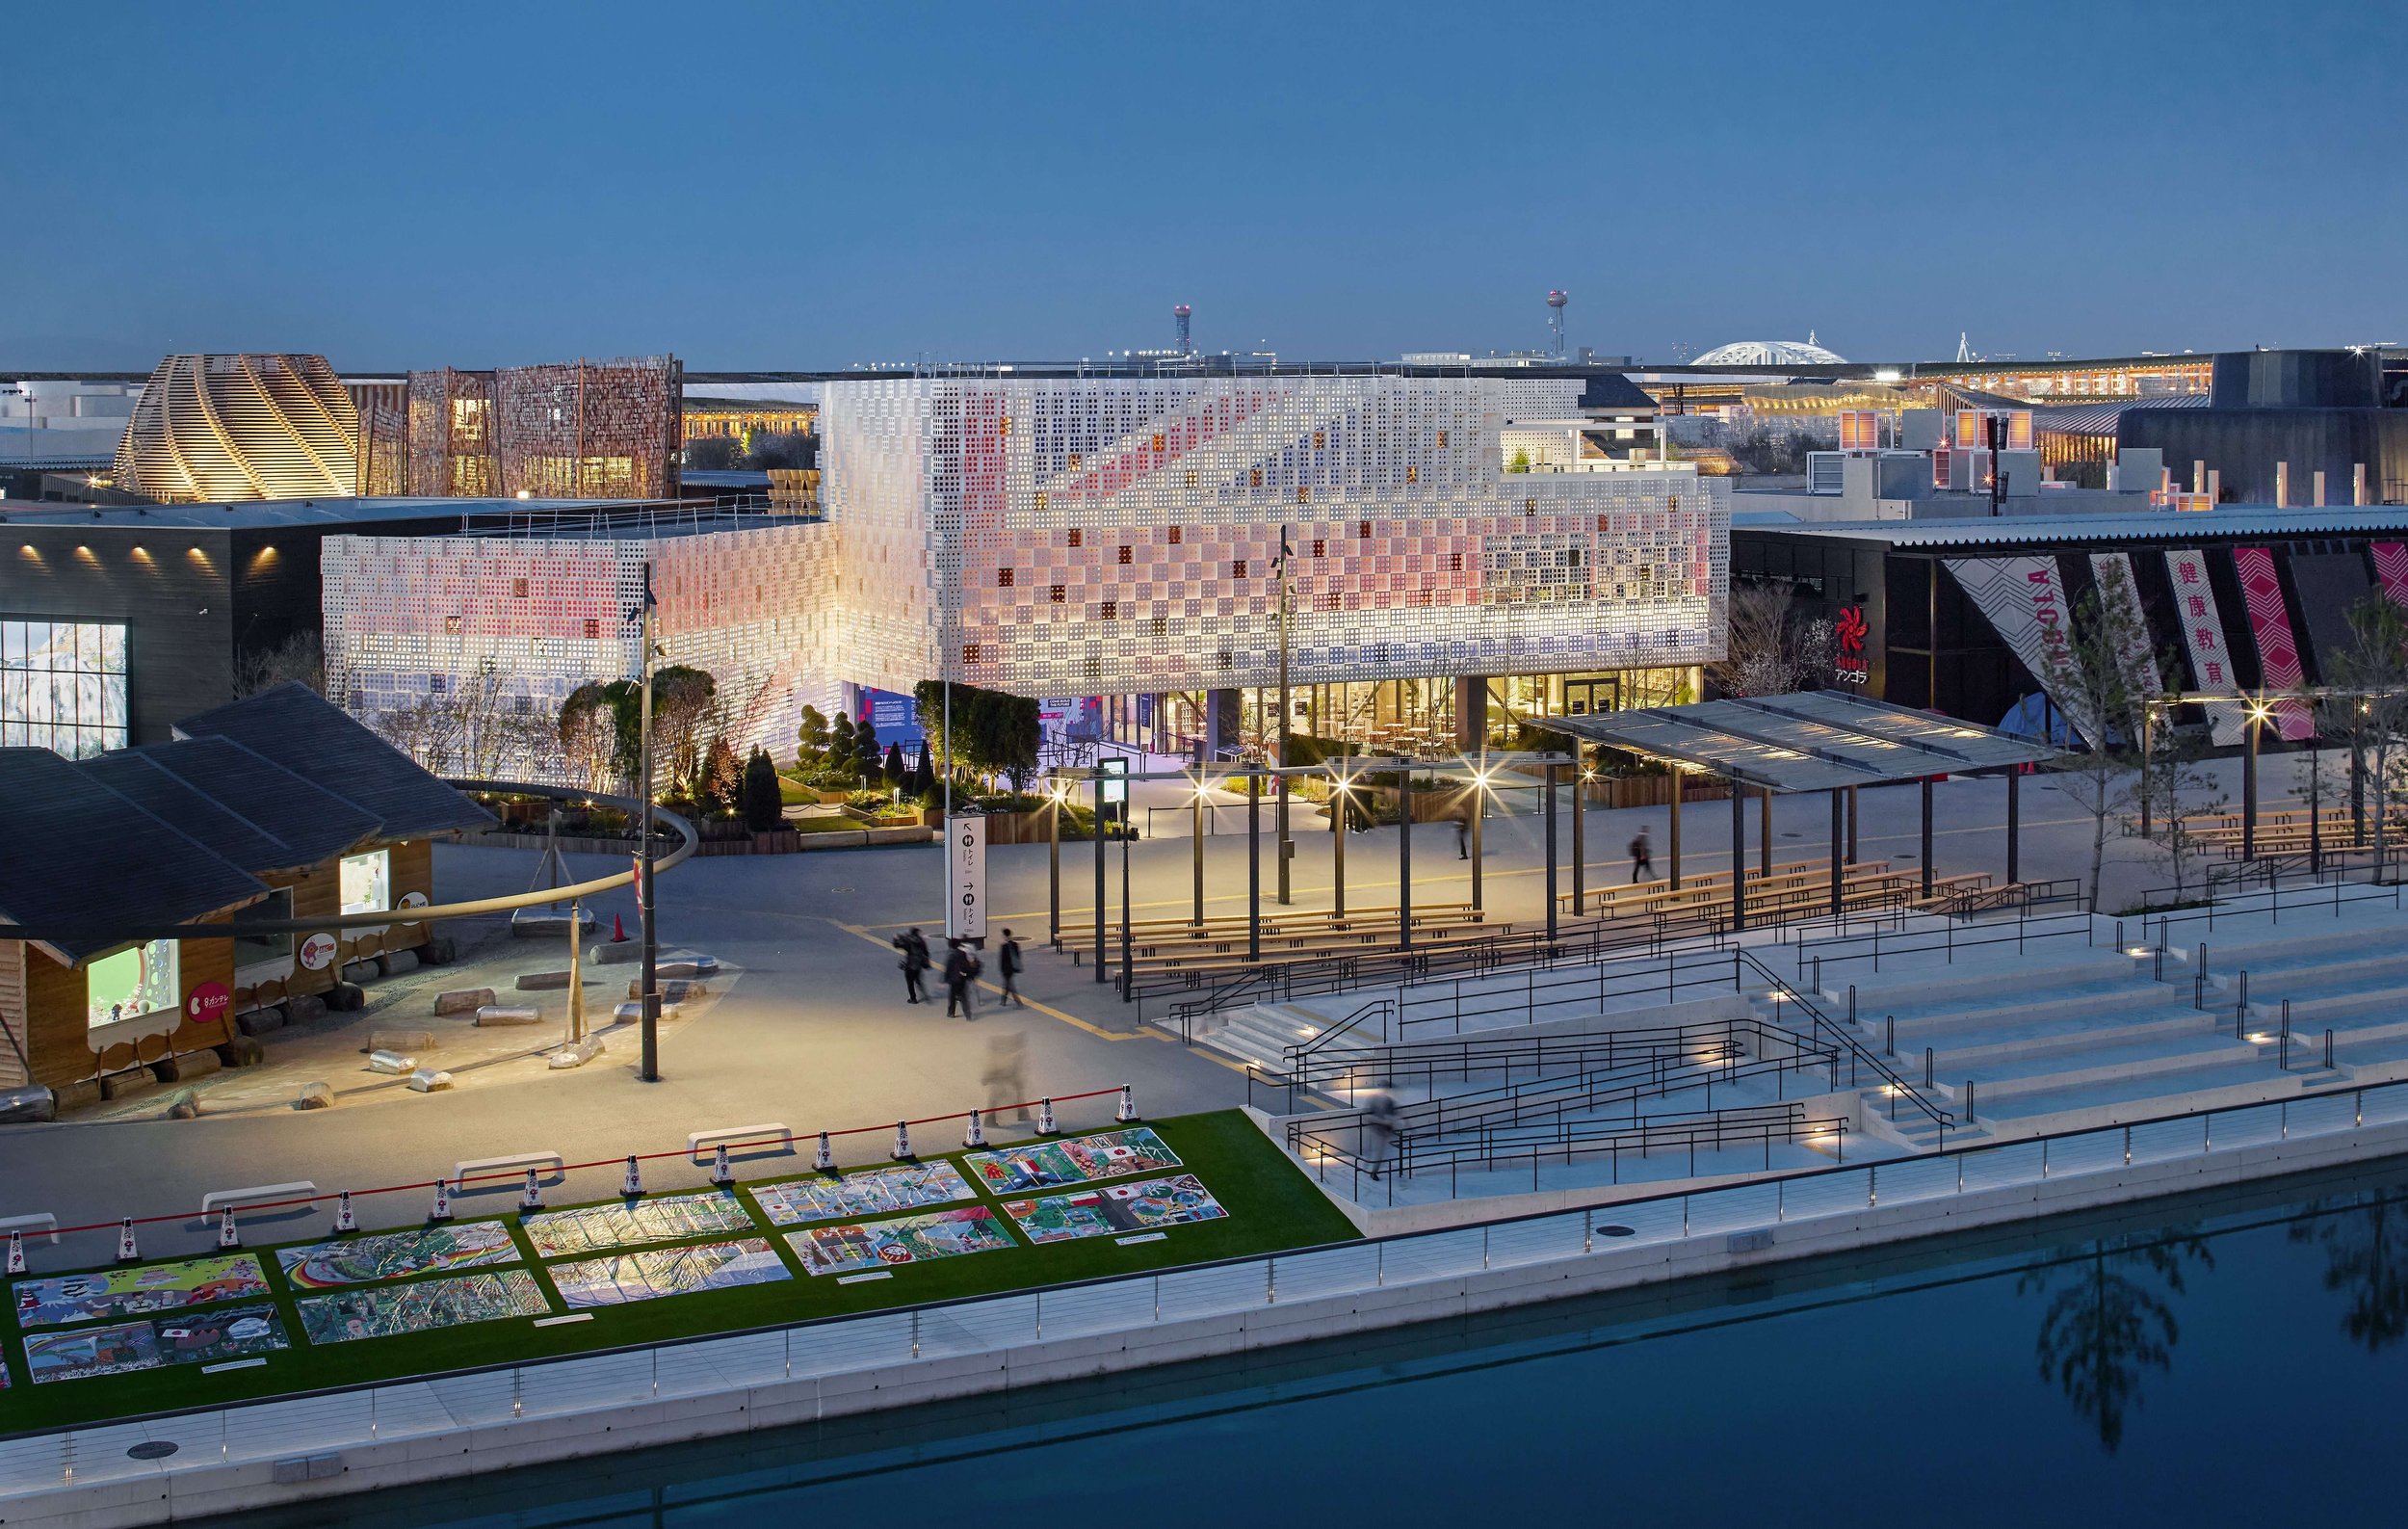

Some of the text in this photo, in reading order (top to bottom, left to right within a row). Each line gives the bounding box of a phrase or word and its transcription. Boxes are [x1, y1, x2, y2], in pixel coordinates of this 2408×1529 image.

[2179, 561, 2223, 684] 健康教育
[1835, 669, 1867, 684] アンゴラ
